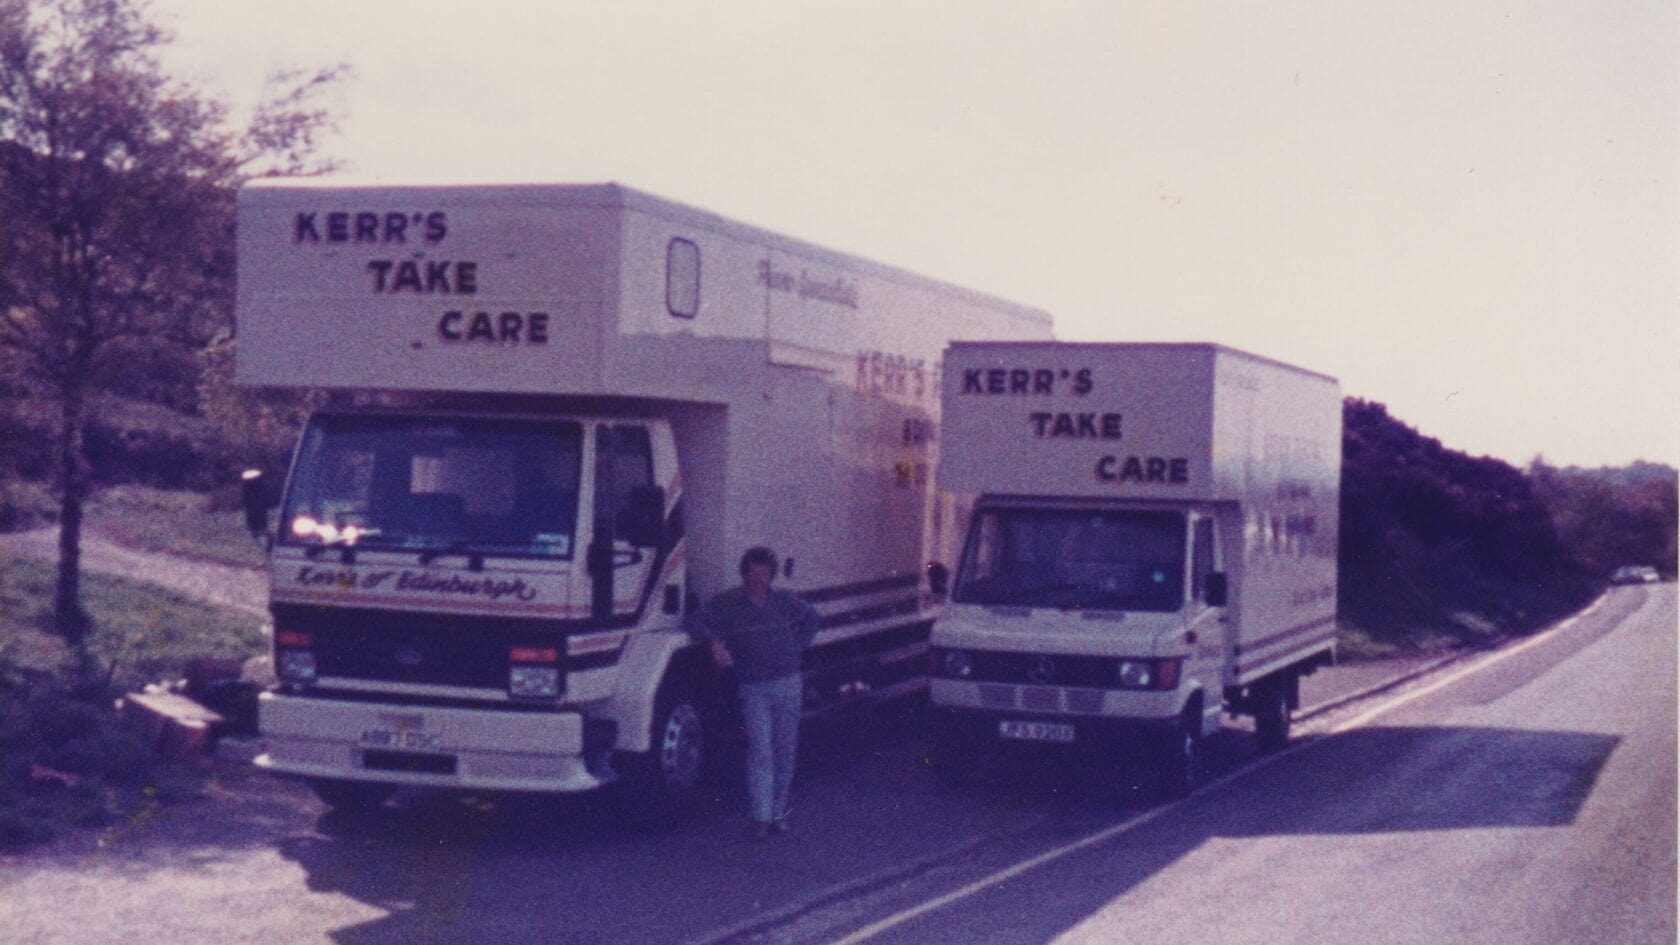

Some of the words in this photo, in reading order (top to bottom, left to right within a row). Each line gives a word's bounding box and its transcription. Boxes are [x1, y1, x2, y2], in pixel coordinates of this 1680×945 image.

[294, 211, 447, 243] KERR'S
[367, 260, 477, 294] TAKE
[437, 311, 550, 343] CARE
[962, 368, 1094, 395] KERR'S
[1030, 412, 1123, 439] TAKE
[1094, 455, 1189, 484] CARE
[396, 569, 537, 600] Edinburgh
